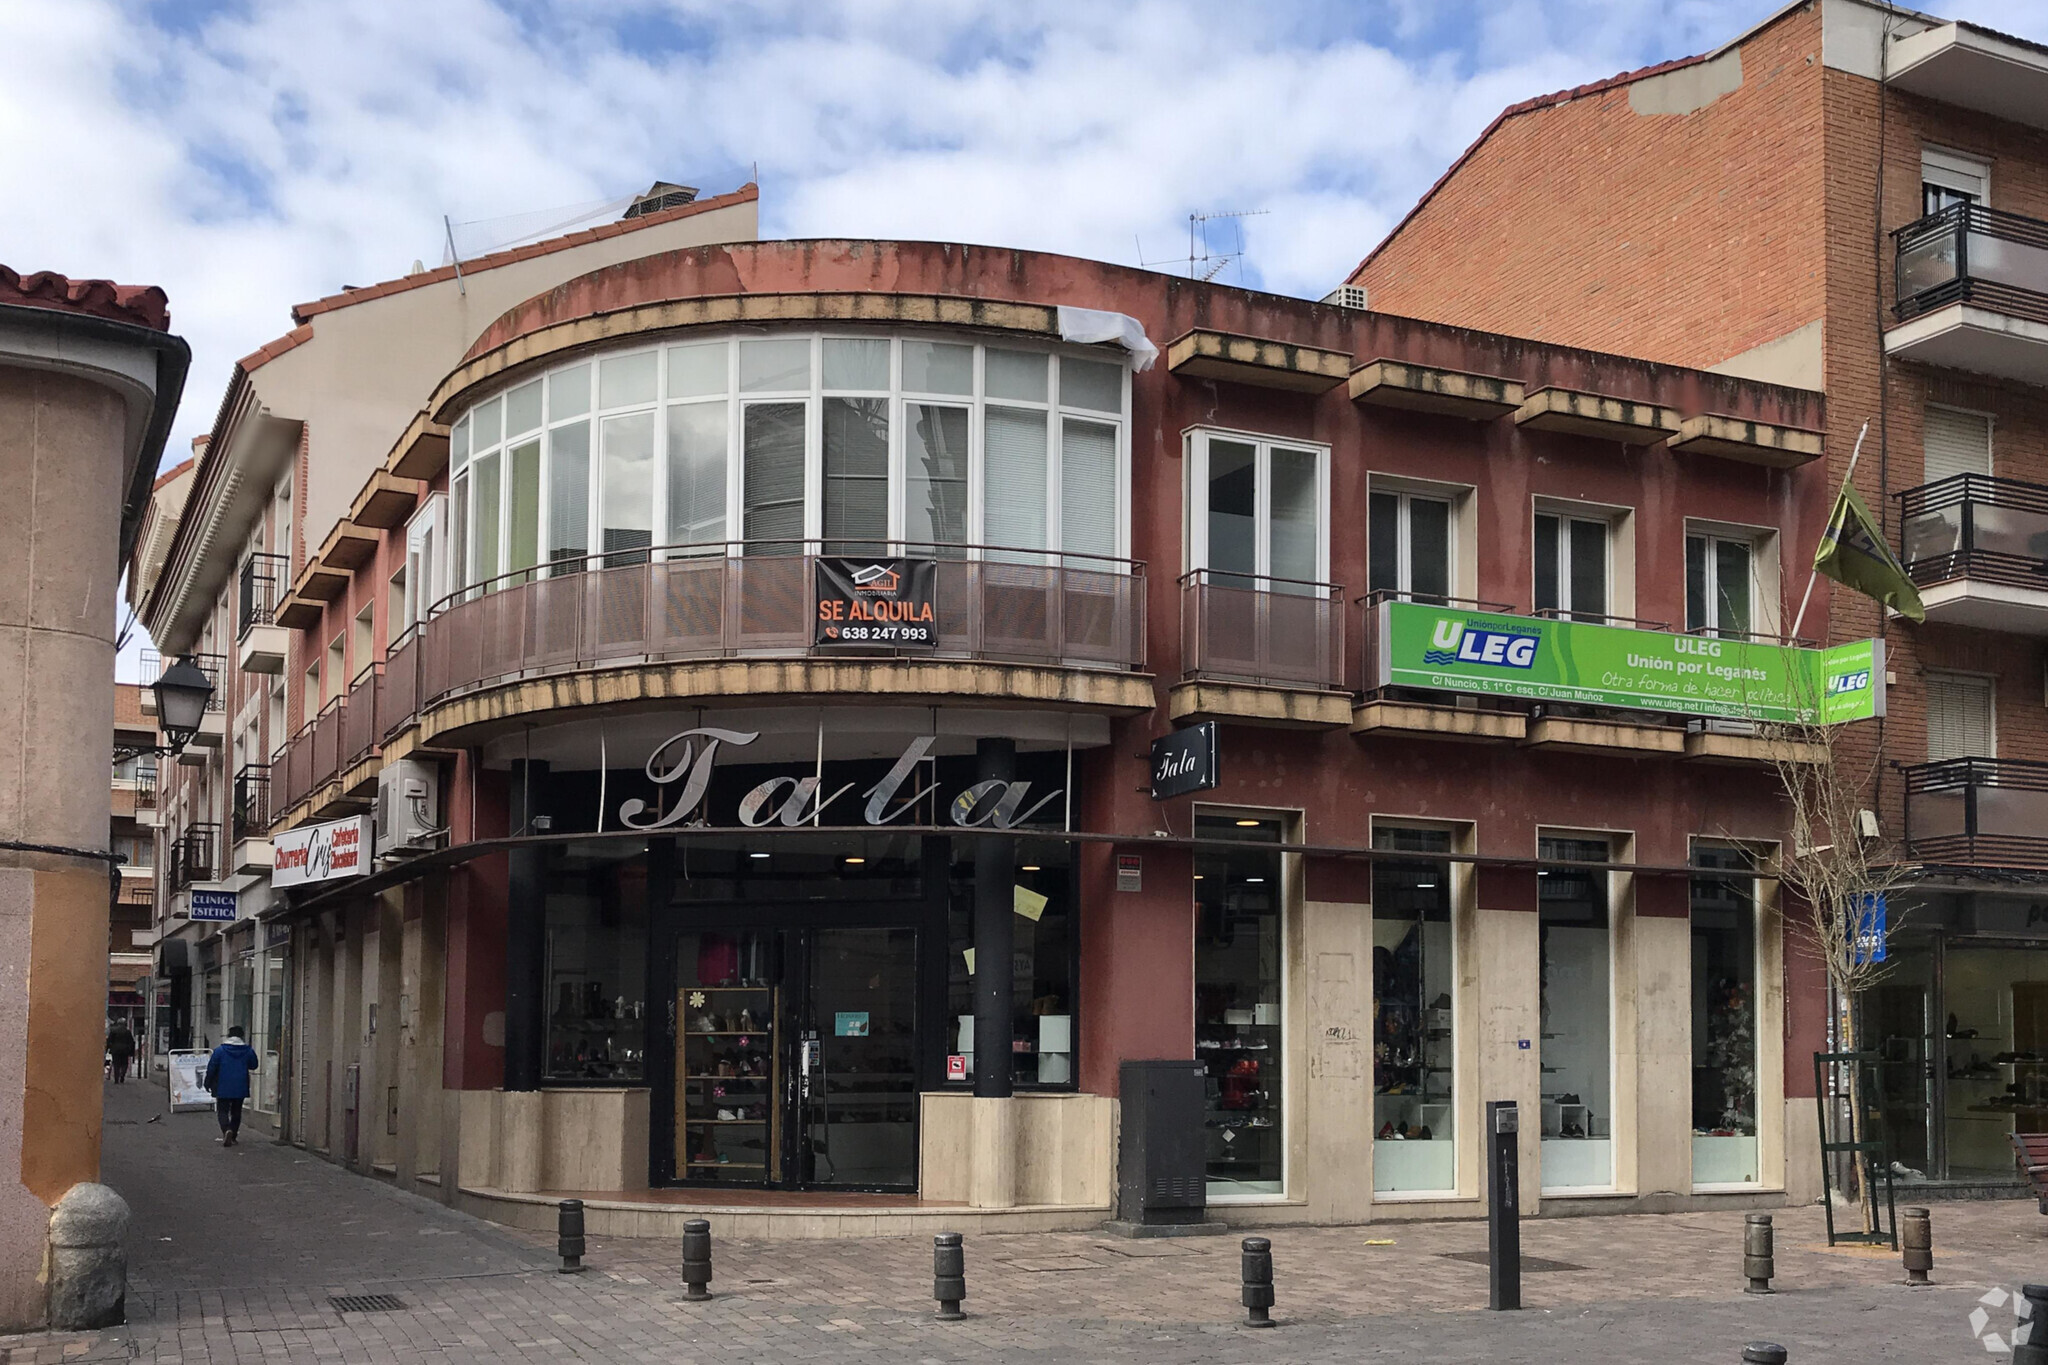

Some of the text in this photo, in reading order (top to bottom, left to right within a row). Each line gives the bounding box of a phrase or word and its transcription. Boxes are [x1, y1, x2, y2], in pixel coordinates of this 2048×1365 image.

[819, 600, 934, 622] SE ALQUILA
[842, 627, 927, 640] 638 247 993
[1432, 620, 1536, 666] ULEG
[1674, 638, 1722, 658] ULEG
[1626, 653, 1767, 681] Unión por Leganés
[1432, 676, 1443, 686] C/
[1444, 676, 1480, 691] Nuncio,
[1504, 683, 1513, 692] C
[1516, 686, 1537, 697] esq.
[1539, 686, 1549, 697] C/
[1550, 688, 1573, 699] Juan
[1574, 690, 1604, 702] Muñoz
[1640, 697, 1699, 714] www.uleg.net
[1602, 671, 1633, 688] Otra
[1638, 673, 1678, 692] forma
[1683, 679, 1699, 694] de
[1704, 682, 1740, 698] hacer
[1156, 748, 1196, 781] Tala
[193, 893, 235, 905] CLÍNICA
[192, 906, 235, 918] ESTÉTICA
